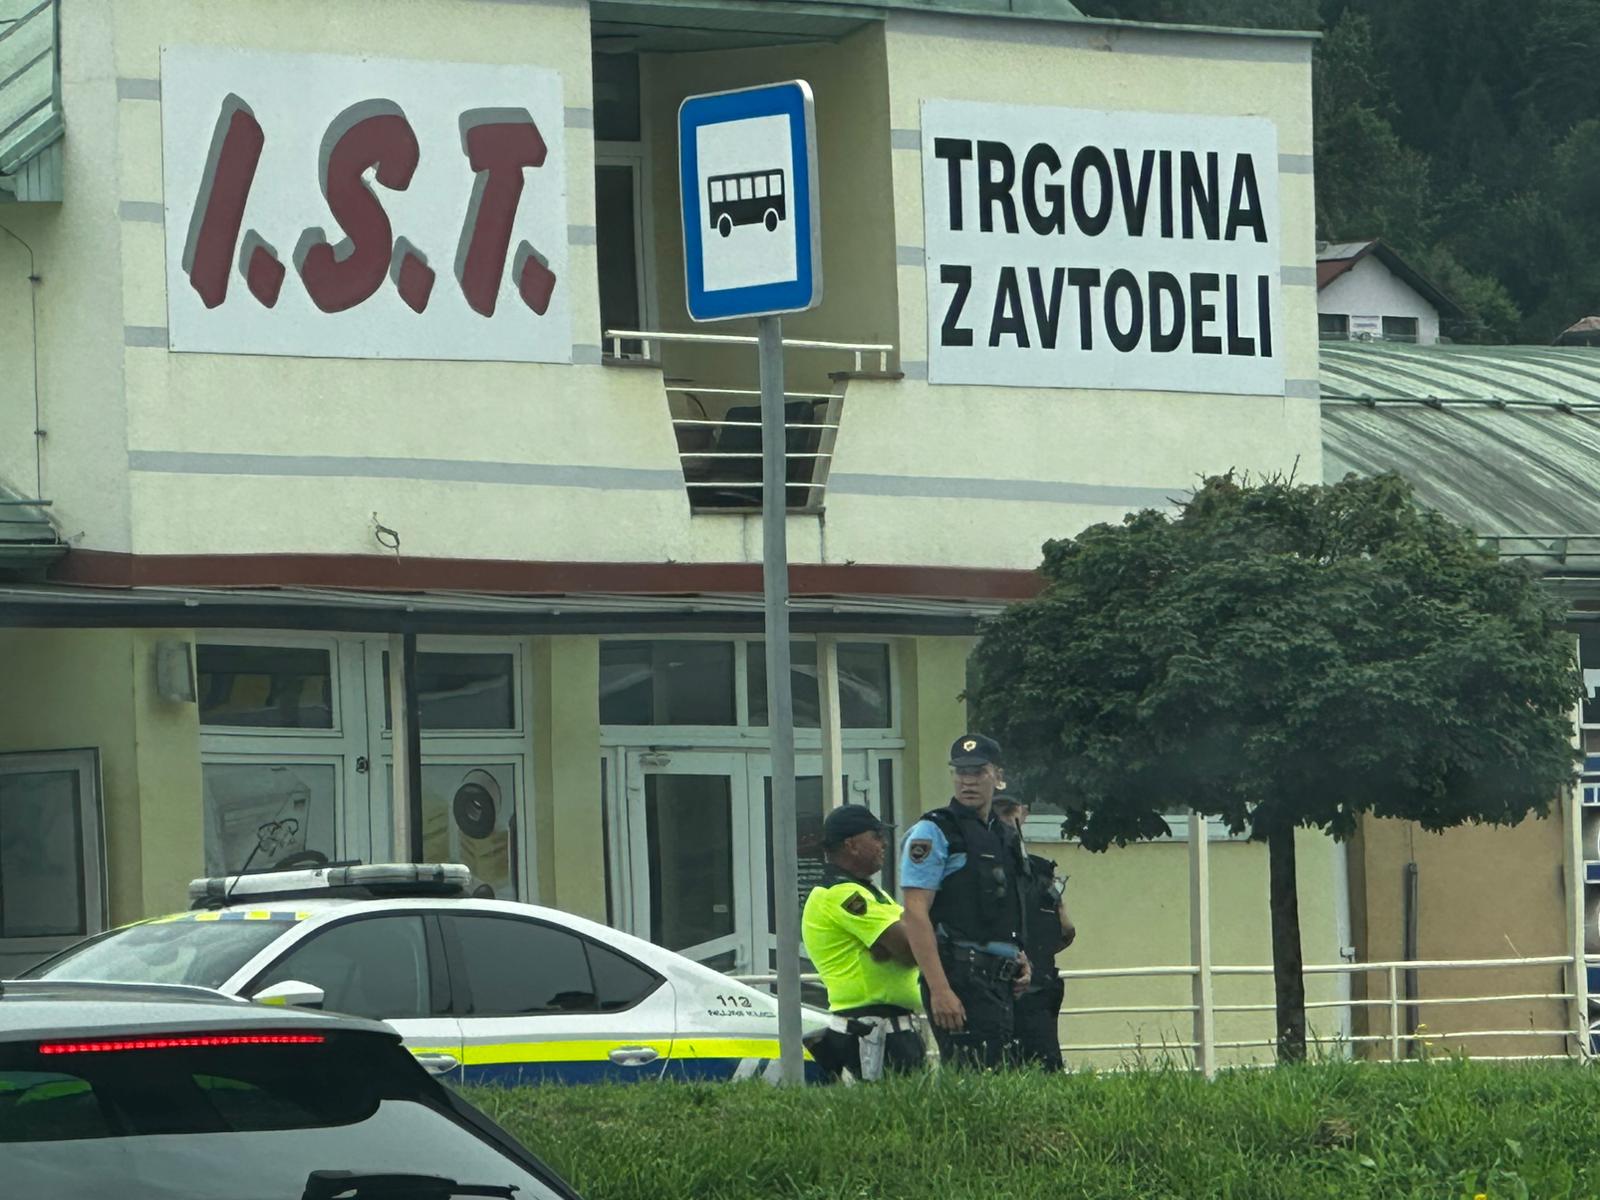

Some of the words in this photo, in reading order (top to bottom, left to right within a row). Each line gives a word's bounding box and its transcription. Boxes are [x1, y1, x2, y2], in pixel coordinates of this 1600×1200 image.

[182, 92, 556, 318] I.S.T.
[934, 137, 1268, 243] TRGOVINA
[940, 264, 974, 347] Z
[988, 266, 1273, 358] AVTODELI
